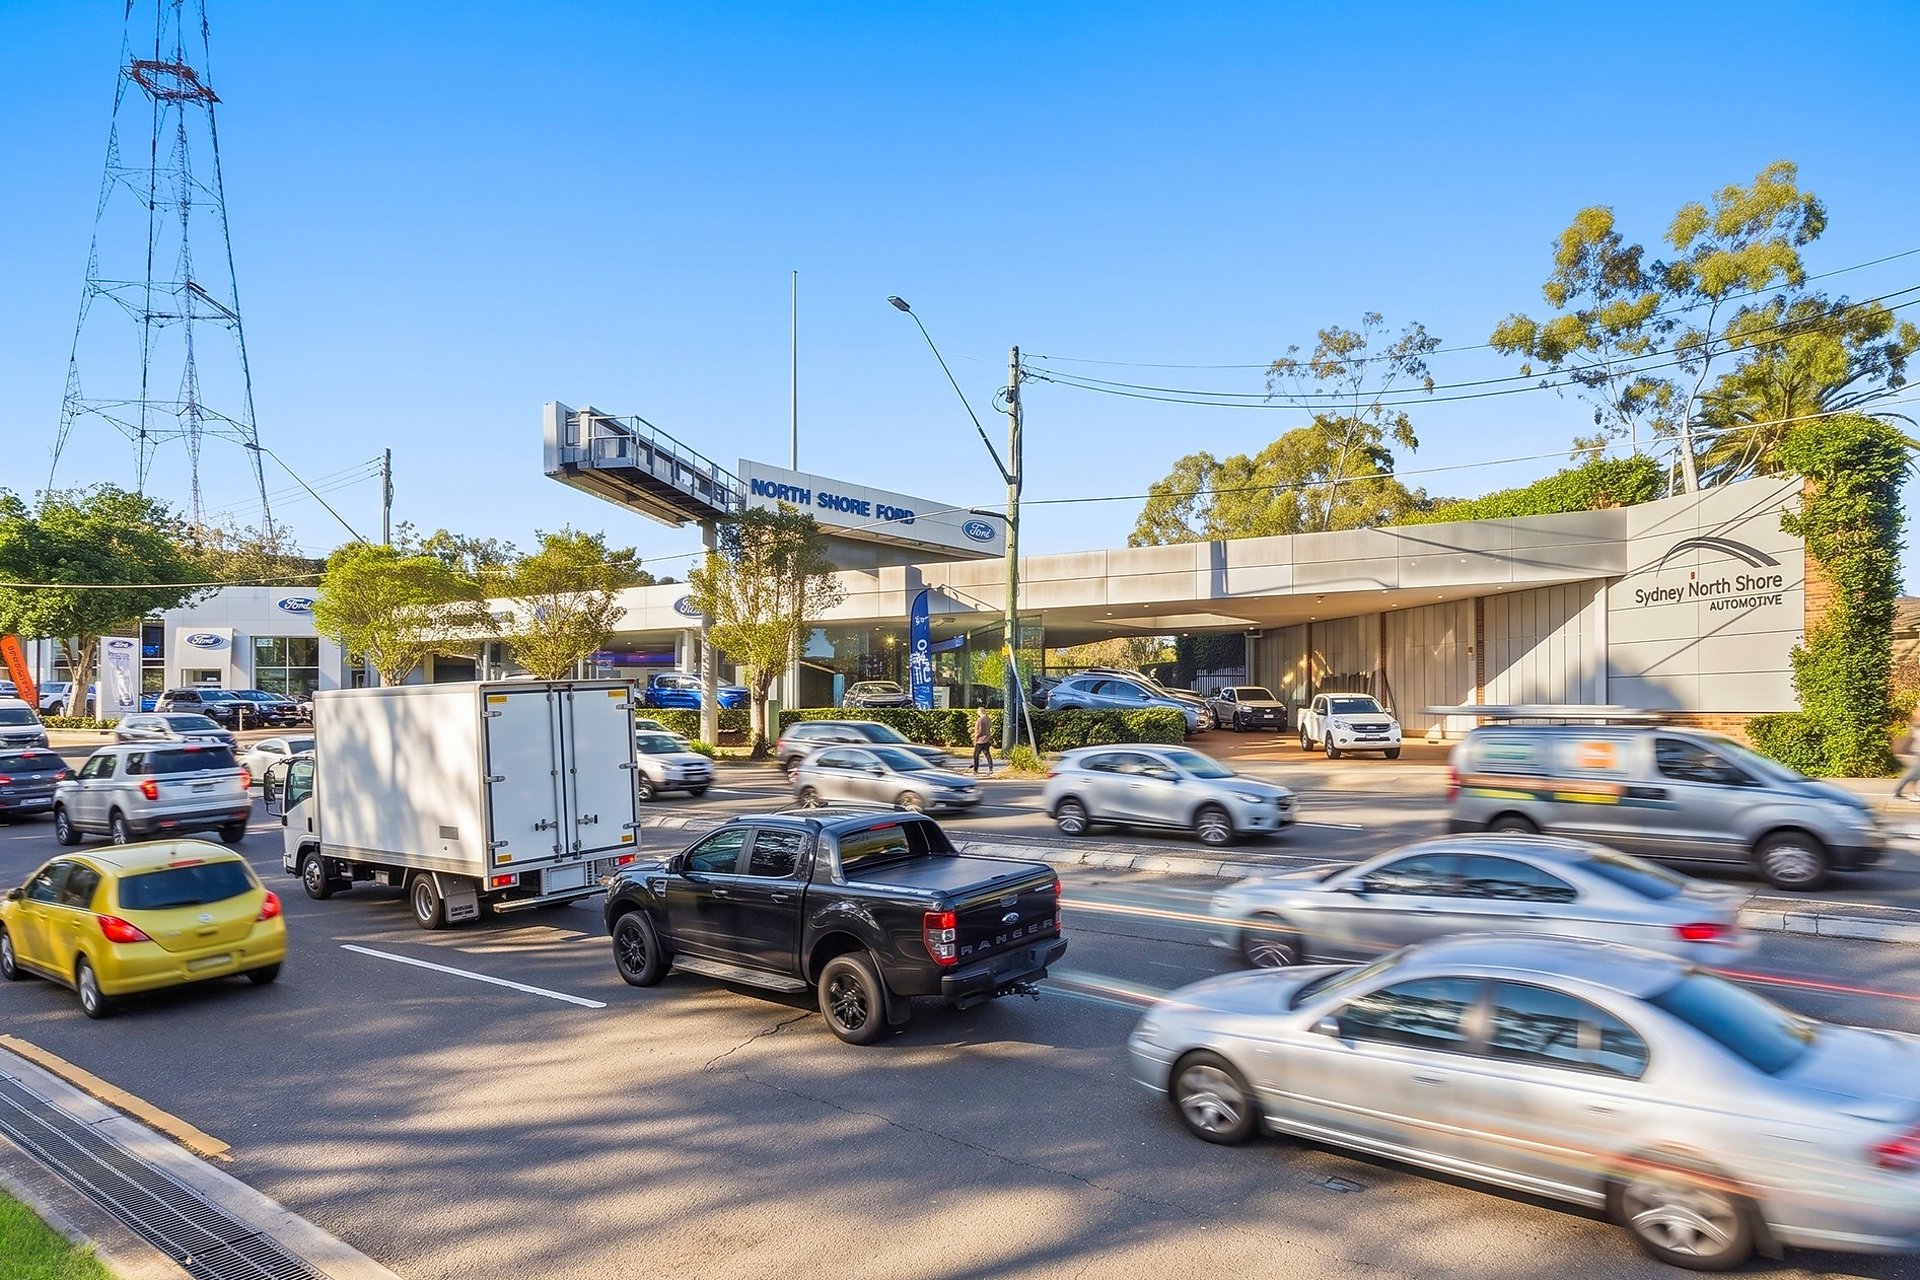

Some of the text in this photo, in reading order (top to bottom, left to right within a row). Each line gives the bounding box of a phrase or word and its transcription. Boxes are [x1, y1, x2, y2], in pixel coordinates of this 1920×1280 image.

[751, 478, 915, 525] NORTH SHORE FORD
[969, 522, 991, 539] Ford
[1635, 574, 1783, 606] Sydney North Shore
[284, 599, 311, 610] Ford
[1709, 594, 1783, 611] AUTOMOTIVE
[191, 634, 215, 645] Ford
[960, 918, 1053, 956] RANGER
